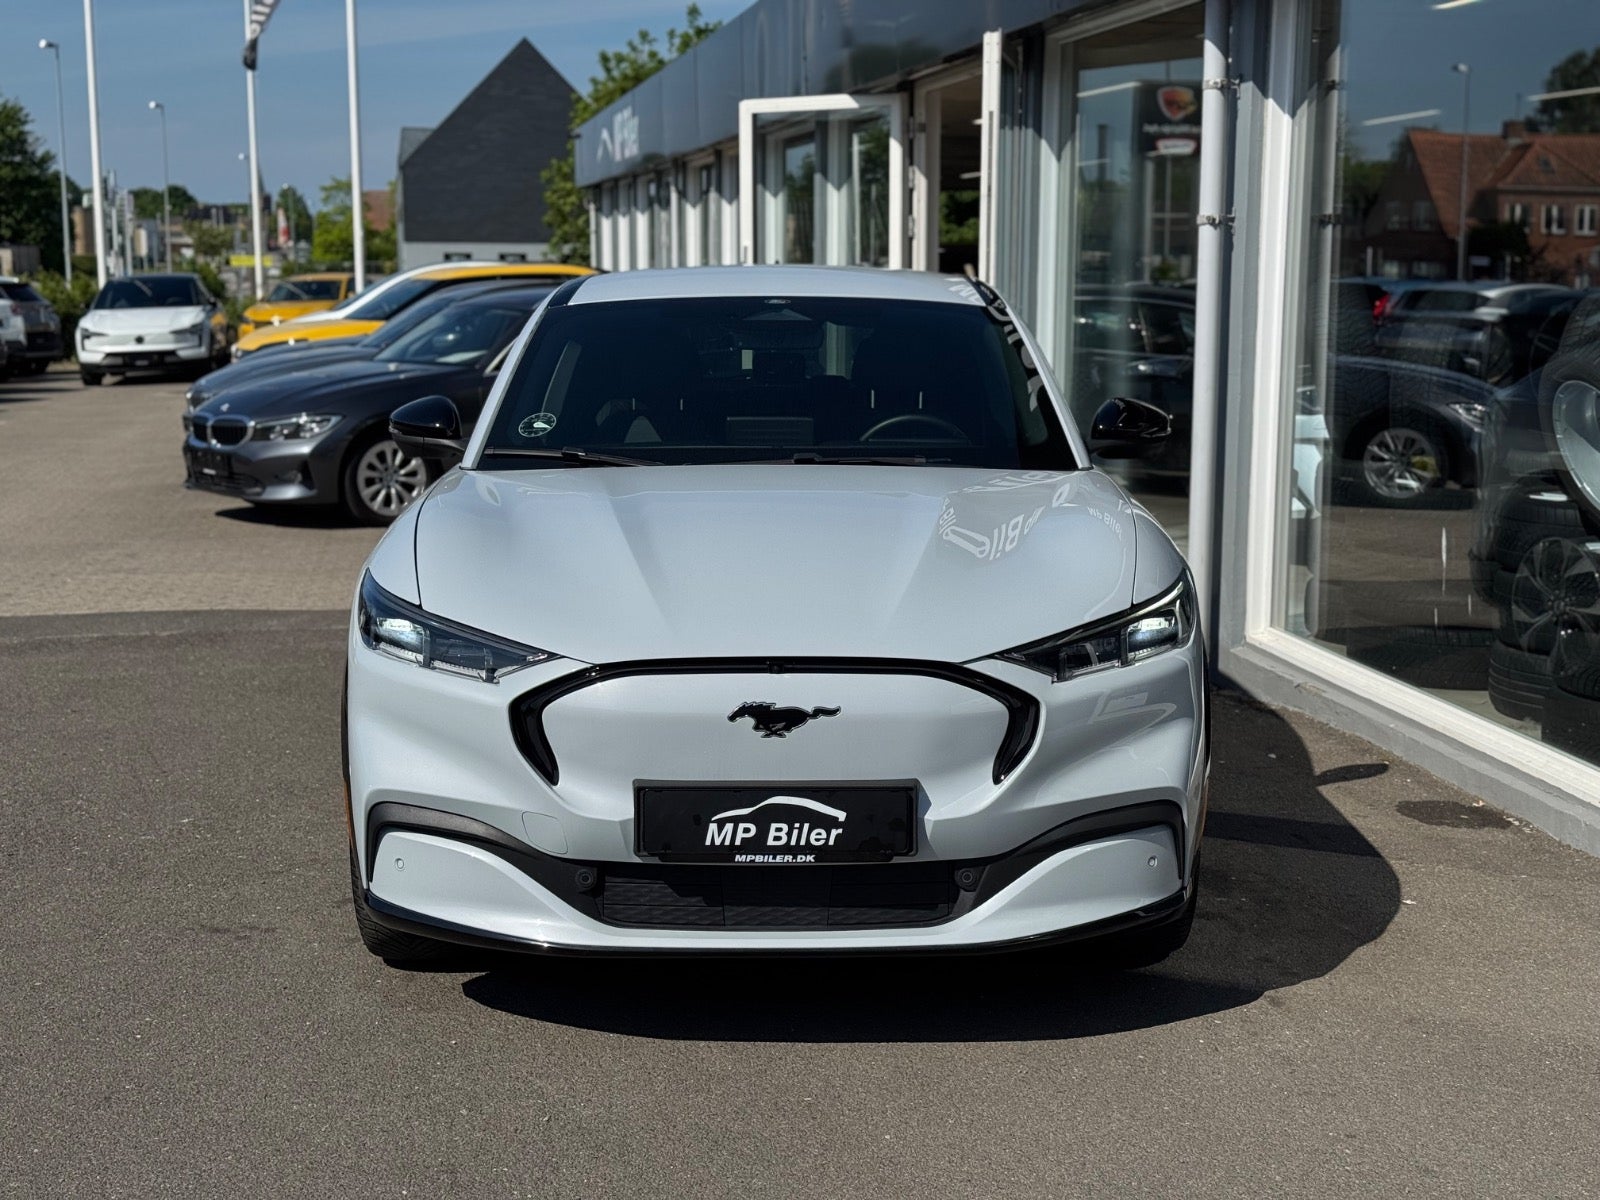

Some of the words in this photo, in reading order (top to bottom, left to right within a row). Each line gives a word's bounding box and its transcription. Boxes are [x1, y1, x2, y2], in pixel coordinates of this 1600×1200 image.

[705, 823, 757, 846] MP
[767, 822, 843, 846] Biler
[734, 854, 815, 863] MPBILER.DK
